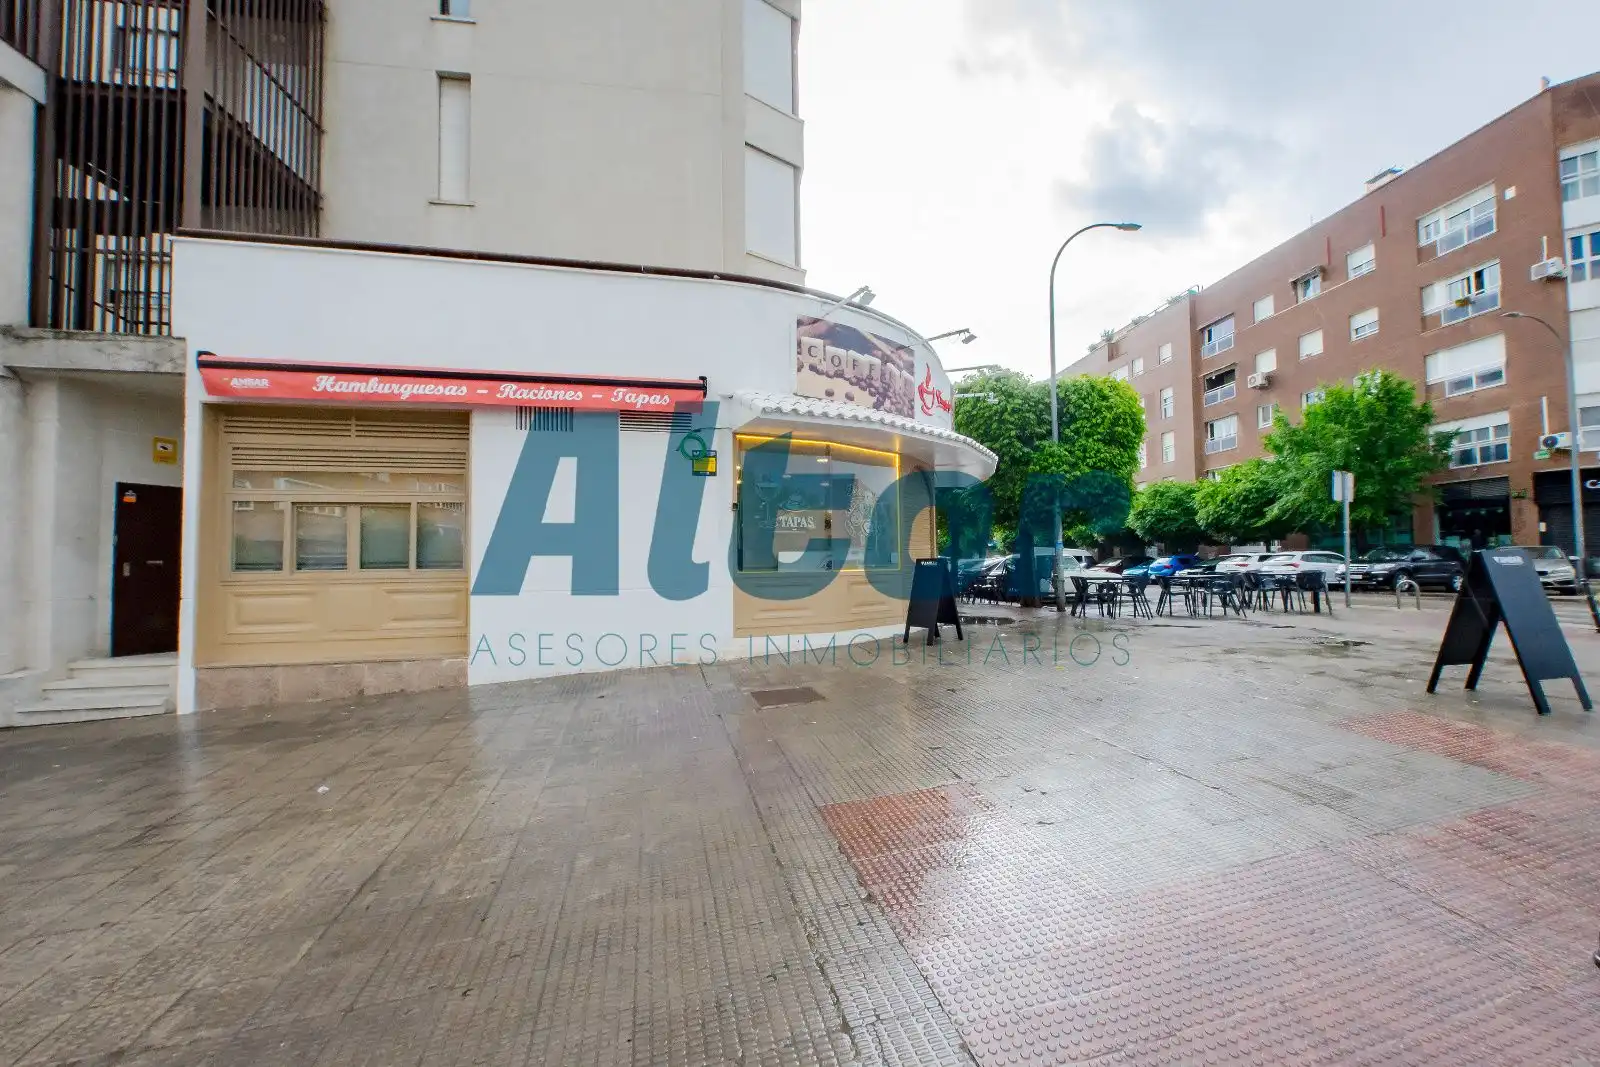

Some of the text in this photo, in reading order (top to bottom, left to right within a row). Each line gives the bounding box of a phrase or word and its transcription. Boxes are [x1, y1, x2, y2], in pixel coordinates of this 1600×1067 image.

[313, 375, 468, 400] Hamburguesas
[496, 383, 583, 401] Raciones
[611, 388, 670, 408] Tapas
